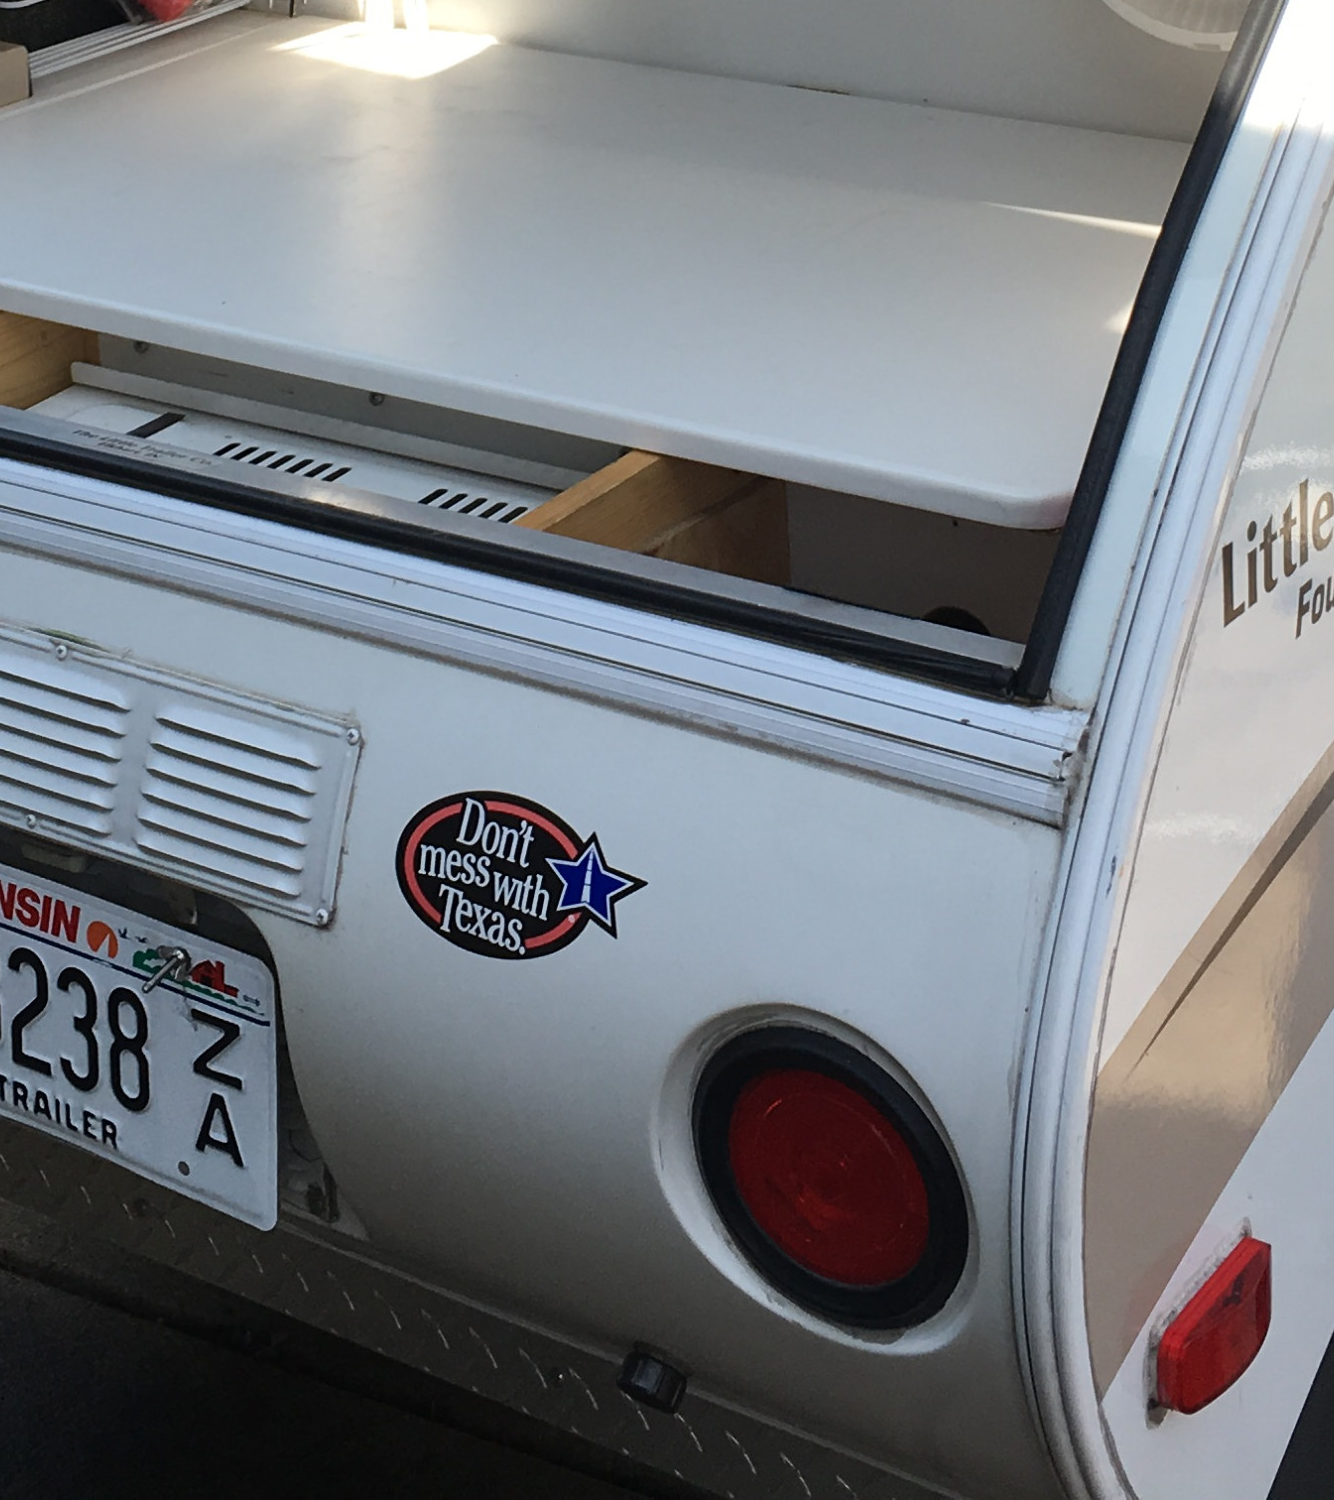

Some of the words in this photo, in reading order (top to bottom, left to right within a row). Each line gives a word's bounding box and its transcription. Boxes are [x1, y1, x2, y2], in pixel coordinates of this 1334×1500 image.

[1222, 477, 1334, 627] Little
[455, 796, 534, 869] Don't
[417, 843, 492, 888] mess
[493, 871, 550, 922] with
[438, 883, 527, 956] Texas.
